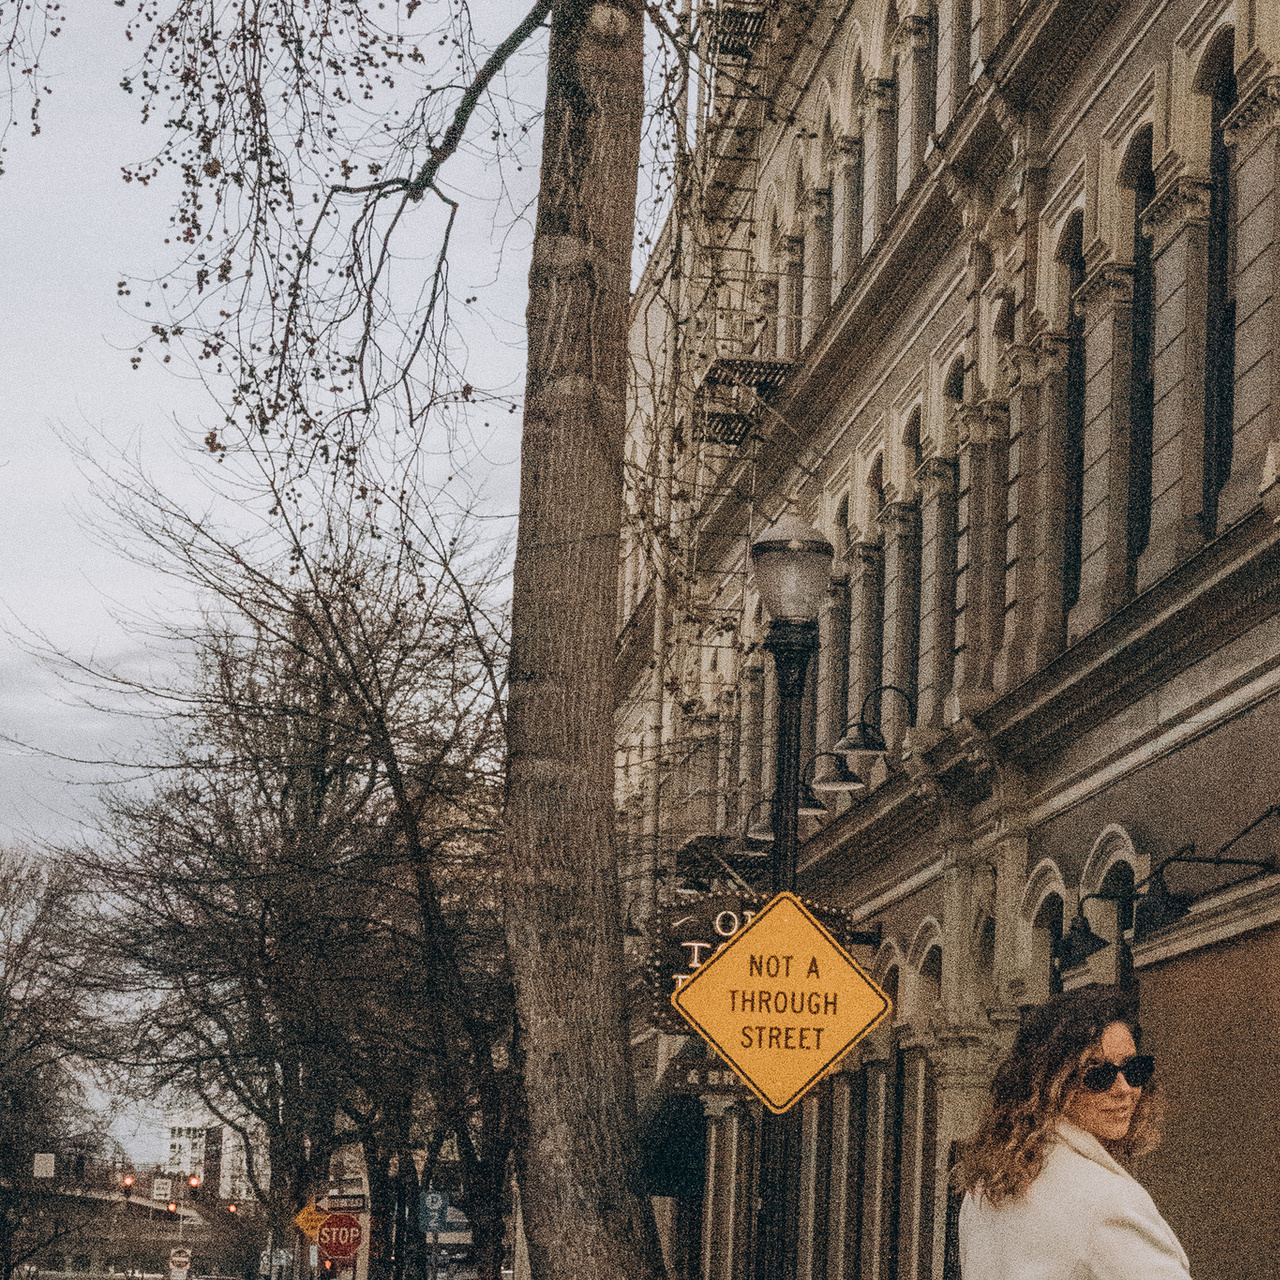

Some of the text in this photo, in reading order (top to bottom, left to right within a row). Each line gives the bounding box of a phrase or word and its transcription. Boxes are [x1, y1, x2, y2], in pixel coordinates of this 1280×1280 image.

[749, 955, 820, 979] NOT A
[729, 990, 839, 1016] THROUGH
[741, 1026, 824, 1051] STREET
[320, 1227, 360, 1244] STOP
